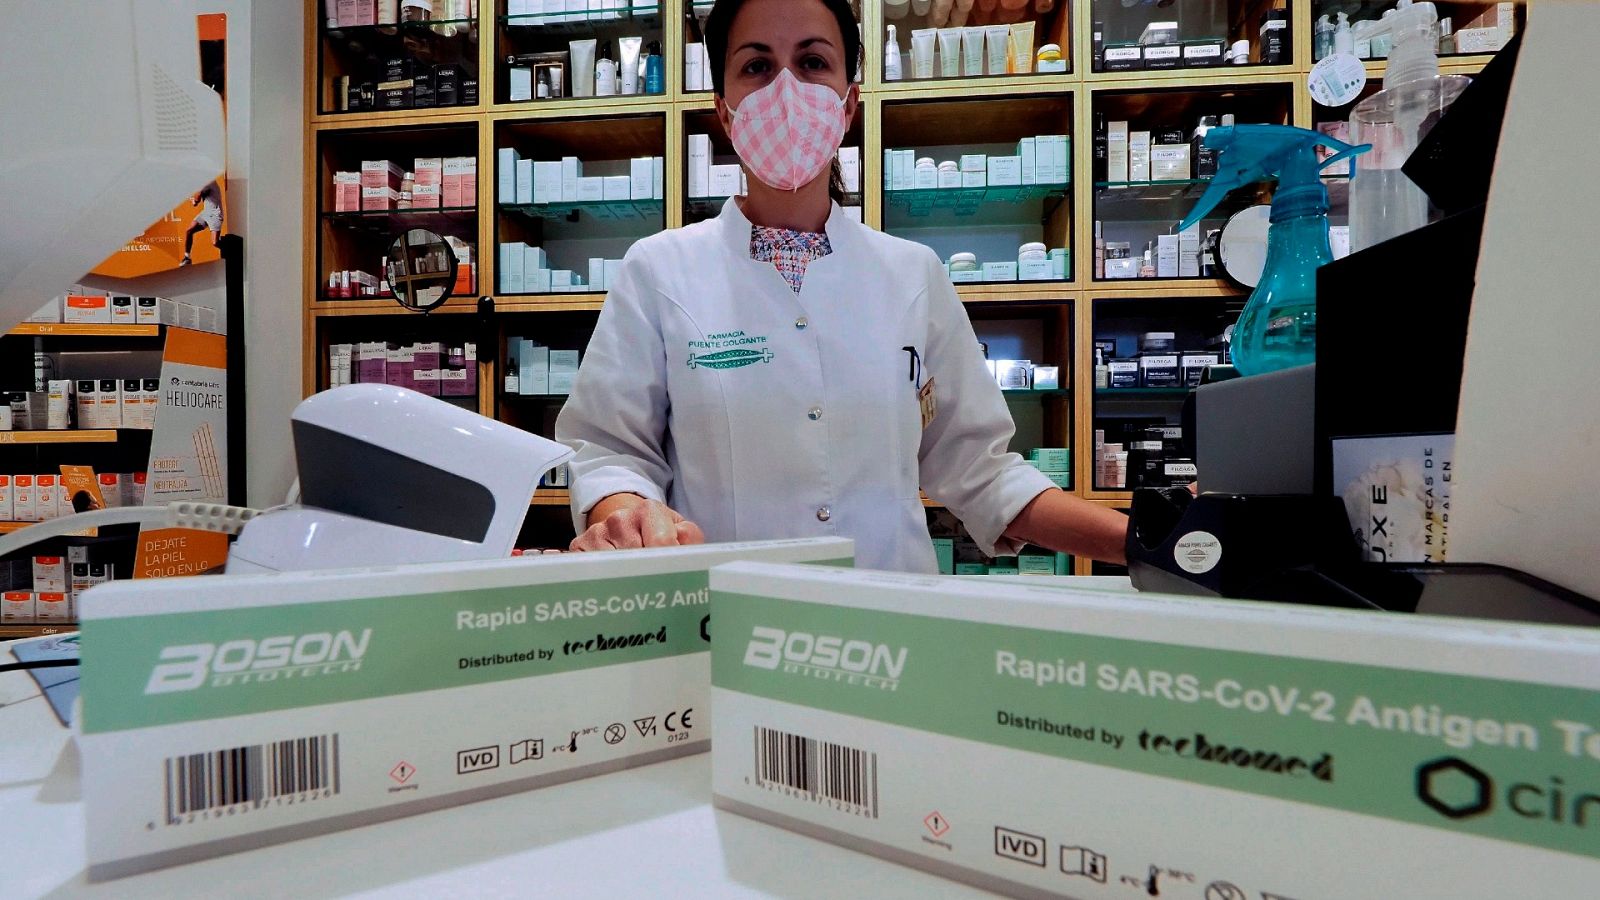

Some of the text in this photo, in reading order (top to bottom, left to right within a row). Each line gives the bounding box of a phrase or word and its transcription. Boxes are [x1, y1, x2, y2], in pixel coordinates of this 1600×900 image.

[688, 336, 767, 349] PUENTE COLGANTE
[708, 330, 745, 340] FARMACIA
[166, 391, 224, 409] HELIOCARE
[1424, 448, 1433, 469] DE
[1442, 461, 1451, 483] EN
[1424, 476, 1434, 545] MARCAS
[145, 536, 187, 552] DÉJATE
[145, 551, 186, 567] LA PIEL
[145, 567, 176, 578] SOLO
[178, 563, 193, 575] EN
[456, 604, 527, 633] Rapid
[533, 591, 667, 622] SARS-CoV-2
[145, 629, 373, 695] BOSON
[458, 648, 555, 670] Distributed by
[743, 626, 909, 678] BOSON
[210, 660, 363, 688] BIOTECH
[783, 662, 900, 692] BIOTECH
[995, 650, 1086, 689] Rapid
[1096, 663, 1335, 722] SARS-CoV-2
[1346, 697, 1538, 751] Antigen
[668, 732, 689, 743] 0123
[997, 711, 1095, 742] Distributed
[1101, 728, 1125, 749] by
[462, 752, 493, 768] IVD
[1002, 834, 1039, 859] IVD
